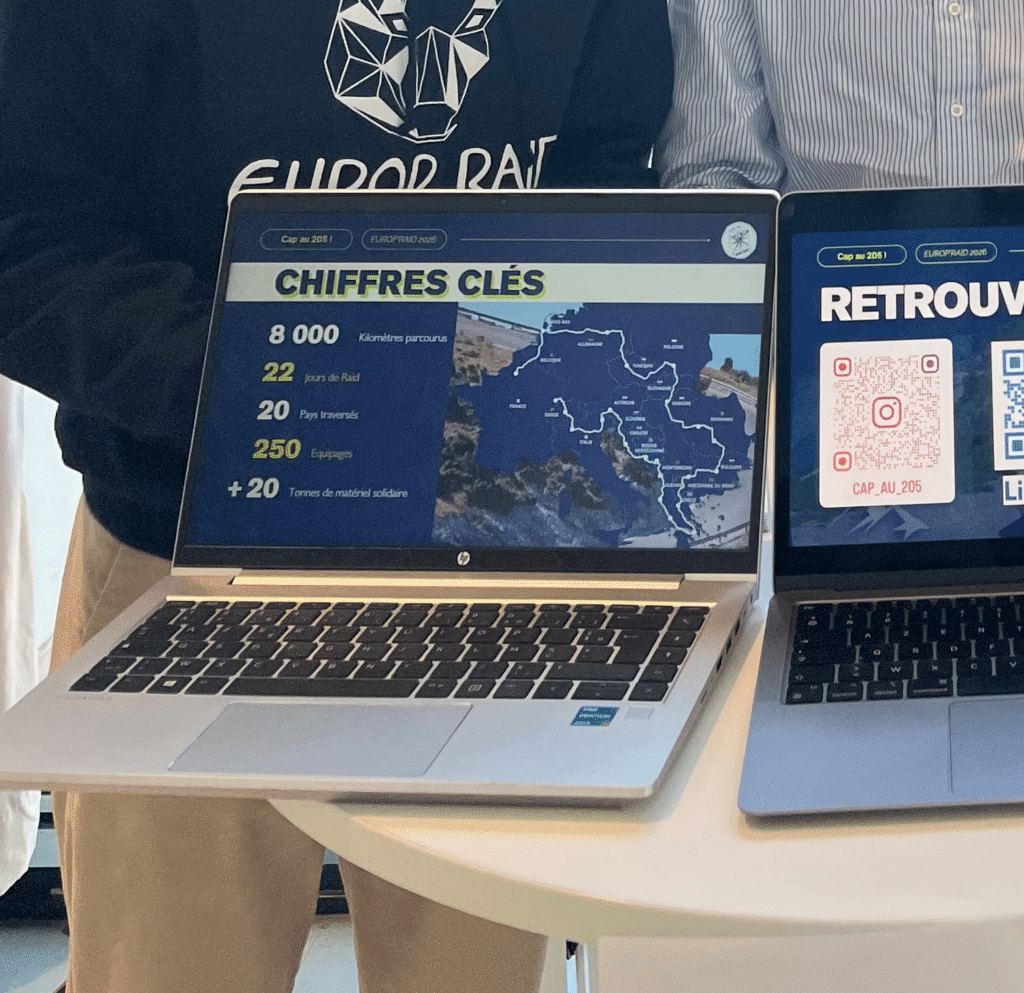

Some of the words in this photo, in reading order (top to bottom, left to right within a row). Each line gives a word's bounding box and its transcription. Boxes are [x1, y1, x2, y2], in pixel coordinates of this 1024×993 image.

[281, 235, 298, 245] Cap
[311, 235, 328, 243] 205
[837, 252, 854, 262] Cap
[866, 251, 883, 260] 205
[275, 269, 449, 298] CHIFFRES
[457, 264, 547, 298] CLÉS
[358, 332, 404, 343] Kilomètres
[405, 334, 448, 345] parcourus
[261, 362, 295, 382] 22
[304, 373, 326, 384] Jours
[328, 372, 340, 382] de
[341, 372, 360, 382] Raid
[257, 400, 290, 420] 20
[299, 409, 318, 421] Pays
[320, 409, 359, 420] traversés
[253, 439, 301, 459] 250
[289, 487, 320, 498] Tonnes
[322, 487, 334, 498] de
[335, 487, 371, 498] matériel
[372, 487, 408, 498] solidaire
[852, 479, 922, 497] CAP_AU_205
